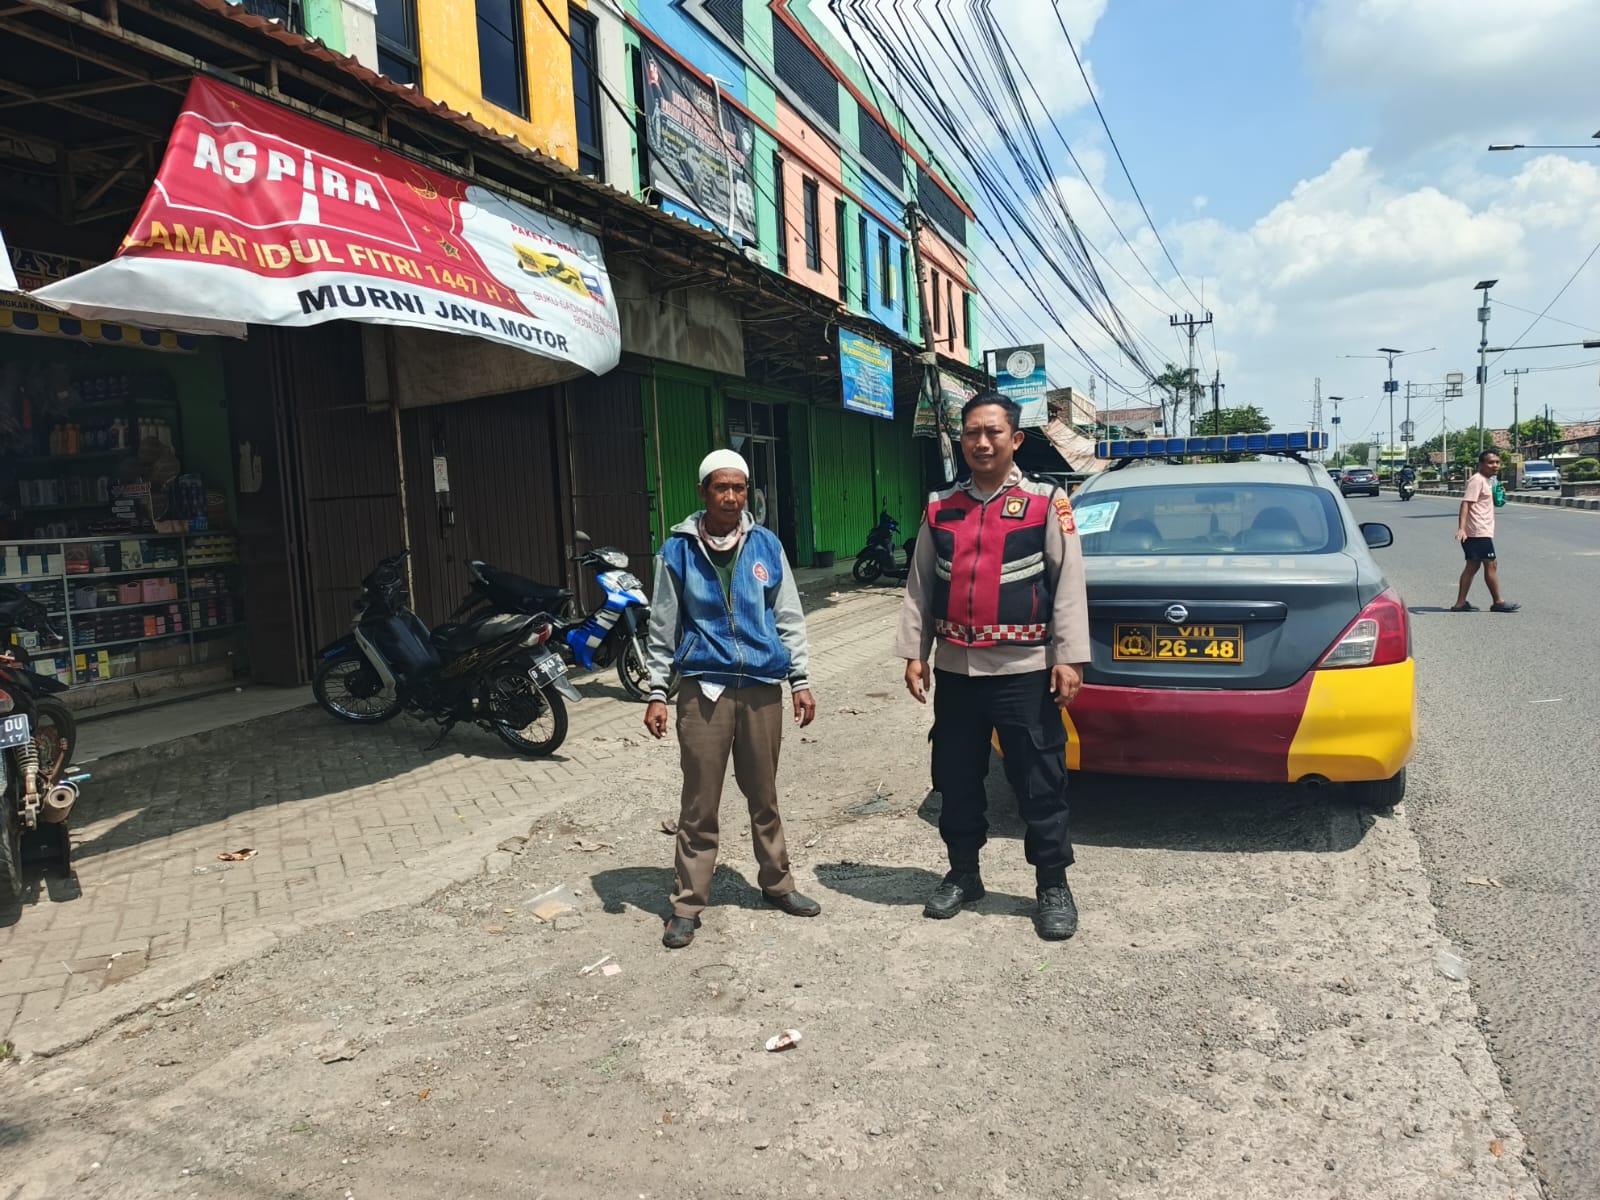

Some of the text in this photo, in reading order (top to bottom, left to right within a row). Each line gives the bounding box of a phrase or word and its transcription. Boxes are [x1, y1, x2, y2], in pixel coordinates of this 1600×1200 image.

[252, 237, 345, 270] IDUL
[346, 243, 423, 280] FITRI
[425, 264, 477, 296] 1447
[482, 281, 502, 303] H
[297, 284, 569, 354] MURNI JAYA MOTOR
